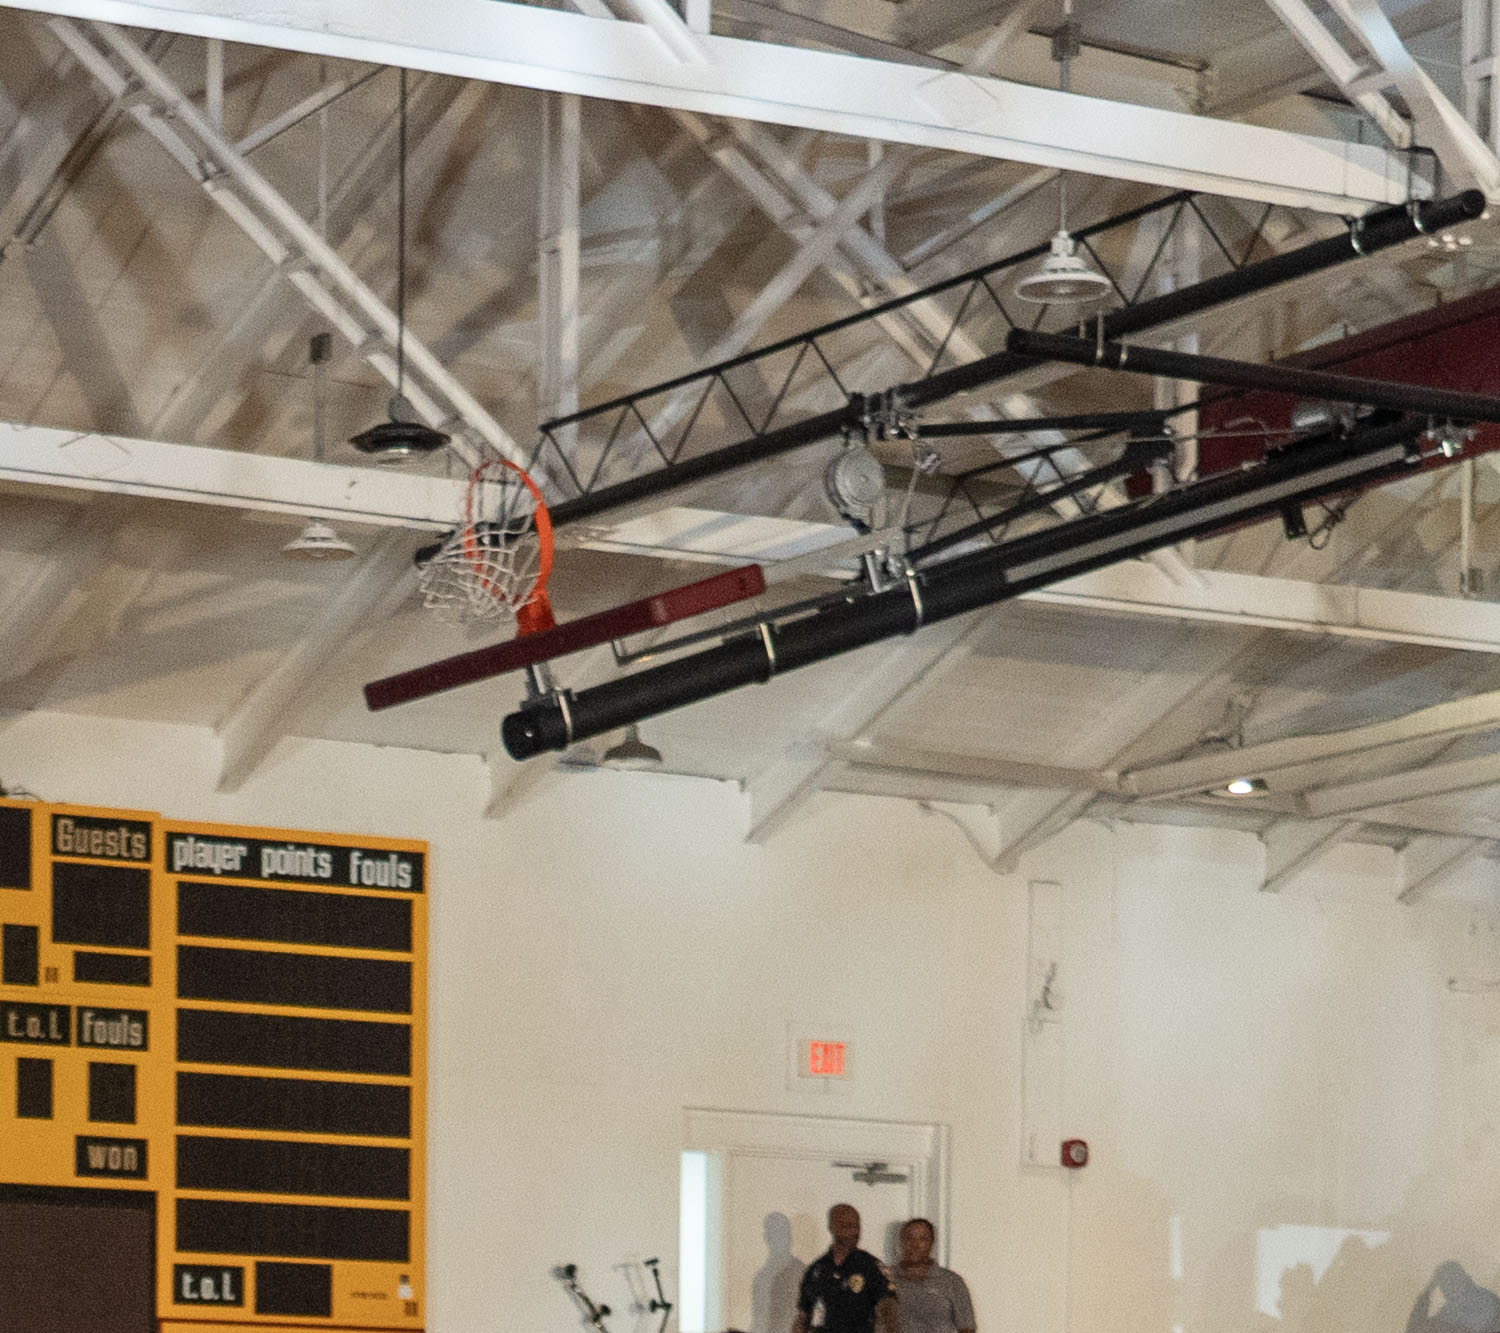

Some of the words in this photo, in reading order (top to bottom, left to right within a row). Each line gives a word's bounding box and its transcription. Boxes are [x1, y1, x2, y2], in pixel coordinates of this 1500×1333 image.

[56, 818, 147, 858] Guests
[173, 838, 247, 874] player
[260, 844, 333, 879] points
[349, 852, 412, 889] fouls
[82, 1011, 143, 1048] fouls
[87, 1143, 138, 1173] won
